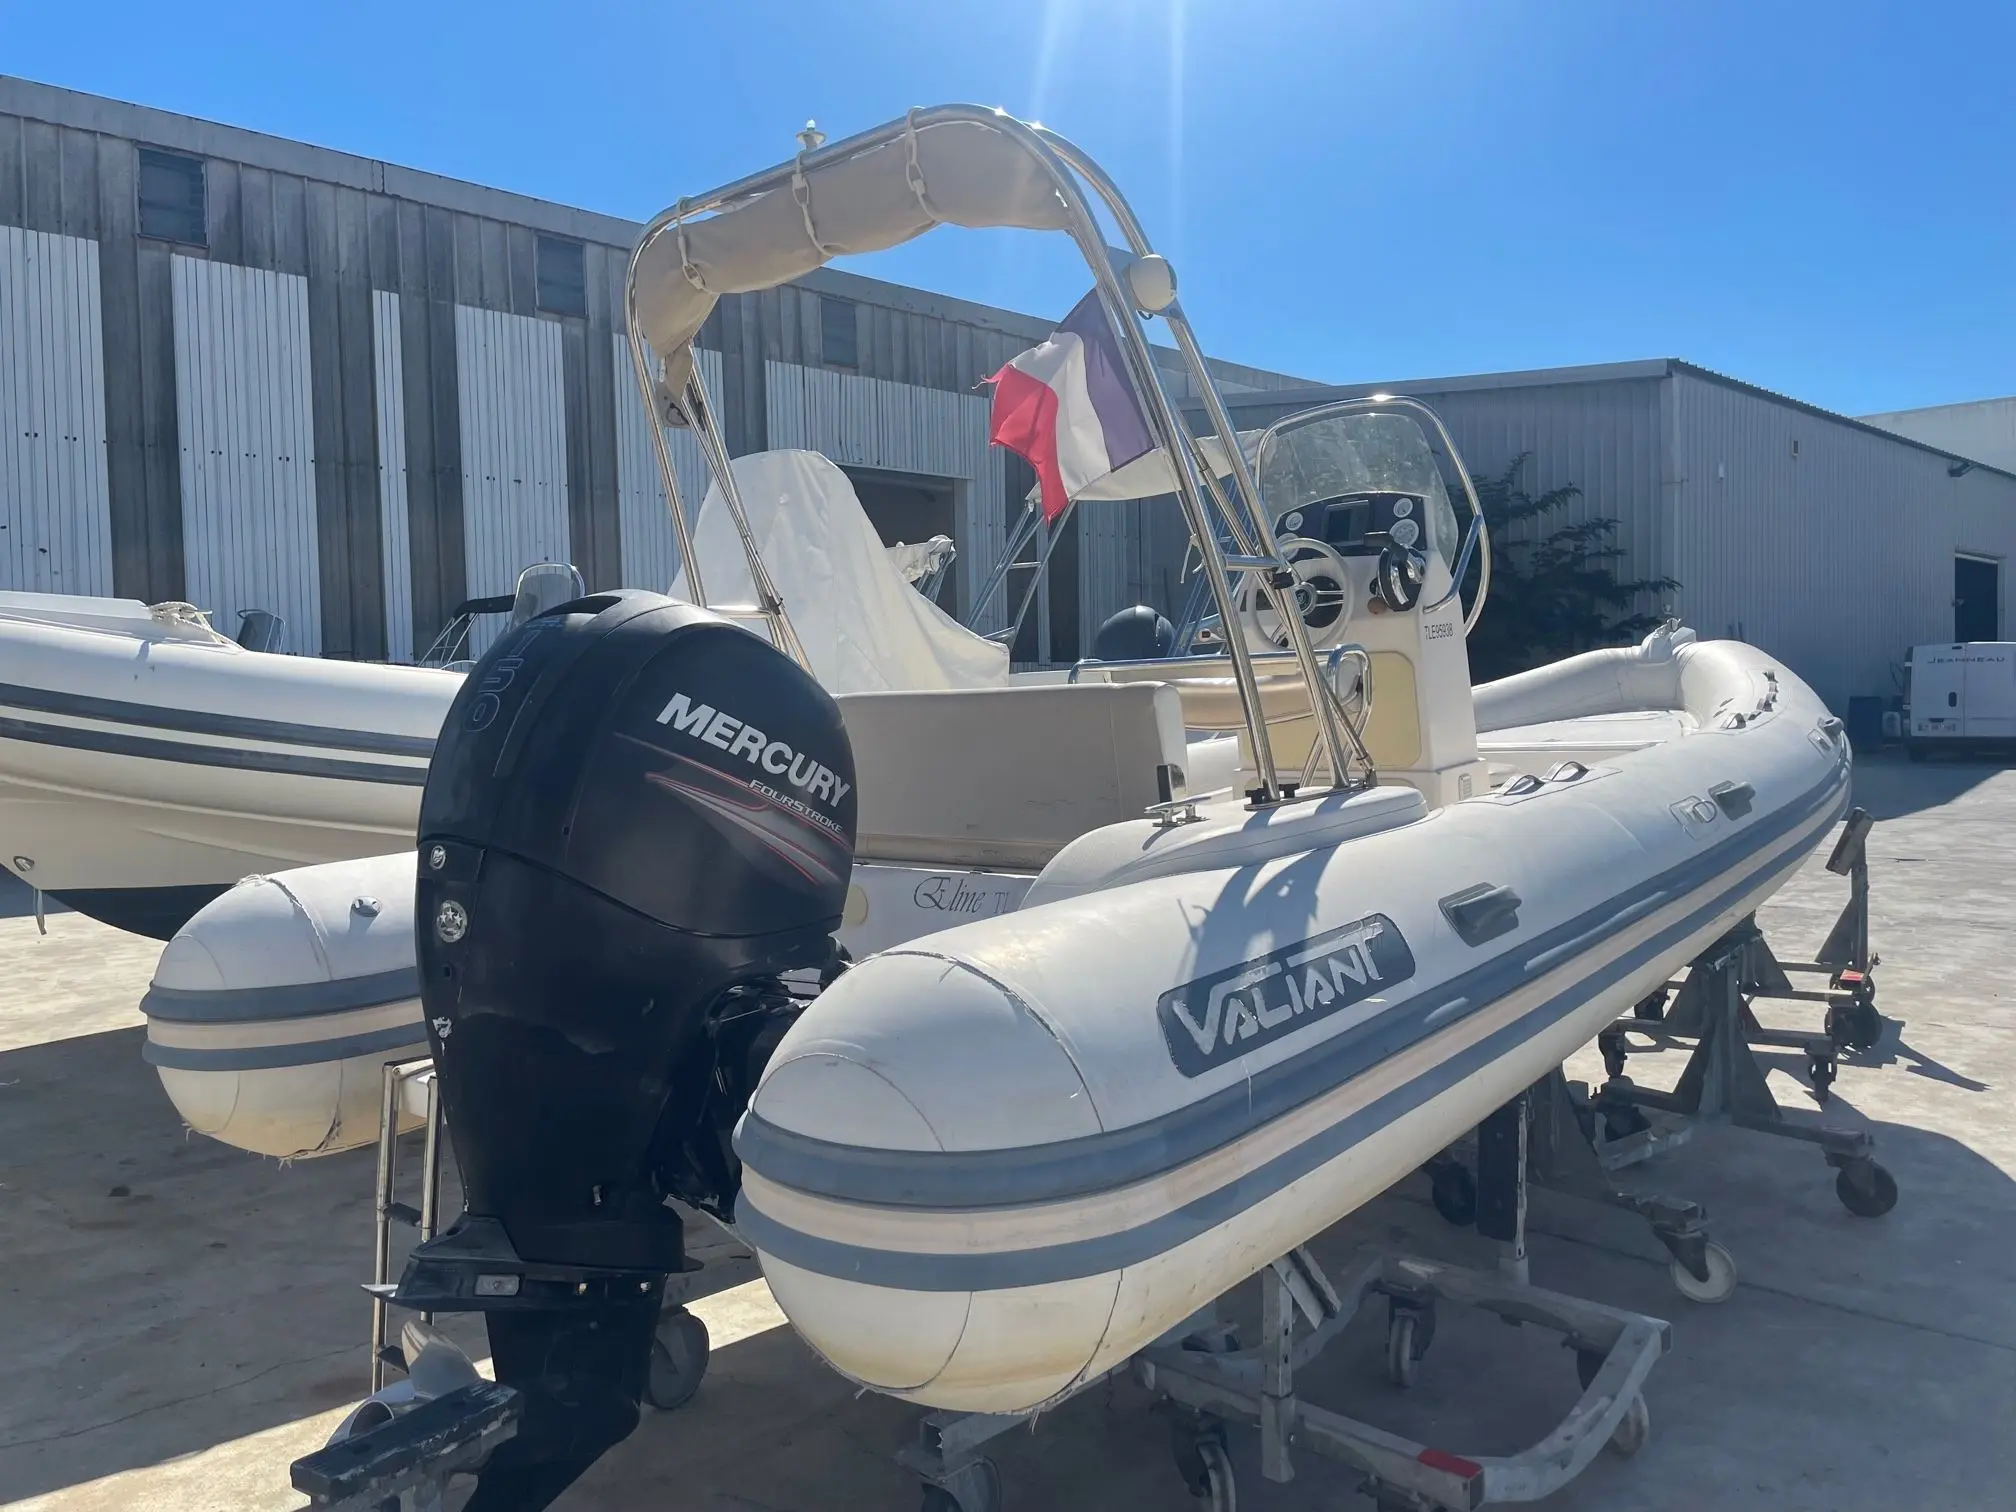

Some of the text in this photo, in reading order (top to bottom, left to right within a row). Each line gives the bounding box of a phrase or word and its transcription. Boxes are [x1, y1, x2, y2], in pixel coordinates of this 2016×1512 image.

[656, 692, 850, 808] MERCURY
[749, 779, 844, 833] FOURSTROKE
[914, 876, 986, 913] Eline
[1172, 922, 1384, 1055] VALIANT
